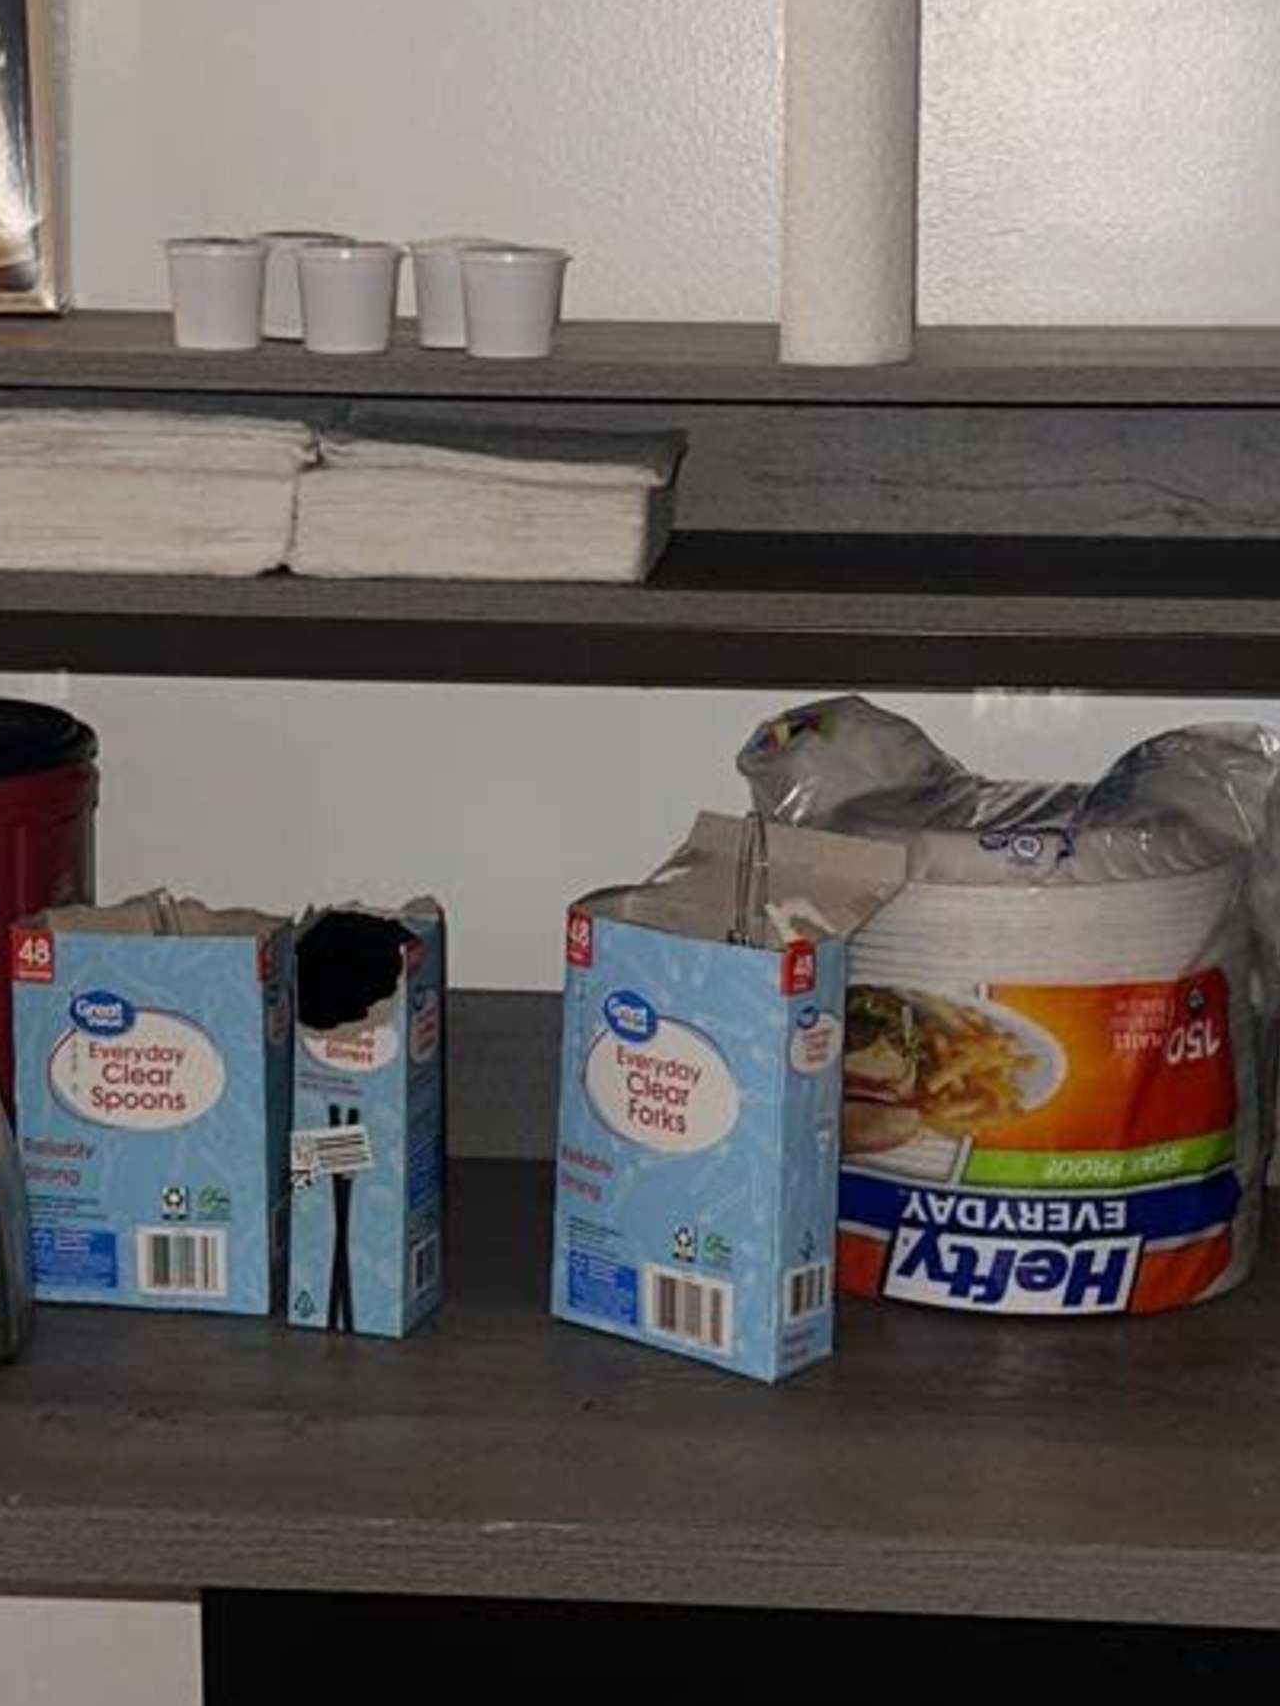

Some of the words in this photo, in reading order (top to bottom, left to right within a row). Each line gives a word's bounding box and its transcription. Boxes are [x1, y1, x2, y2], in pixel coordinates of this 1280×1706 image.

[18, 937, 51, 967] 48
[88, 1043, 187, 1065] Everyday
[1166, 1017, 1221, 1066] 150
[102, 1063, 175, 1085] Clear
[616, 1044, 703, 1086] Everyday
[89, 1087, 188, 1115] Spoons
[626, 1071, 690, 1107] Clear
[628, 1098, 687, 1135] Forks
[902, 1190, 1128, 1233] EVERYDAY
[894, 1229, 1132, 1308] Hefty
